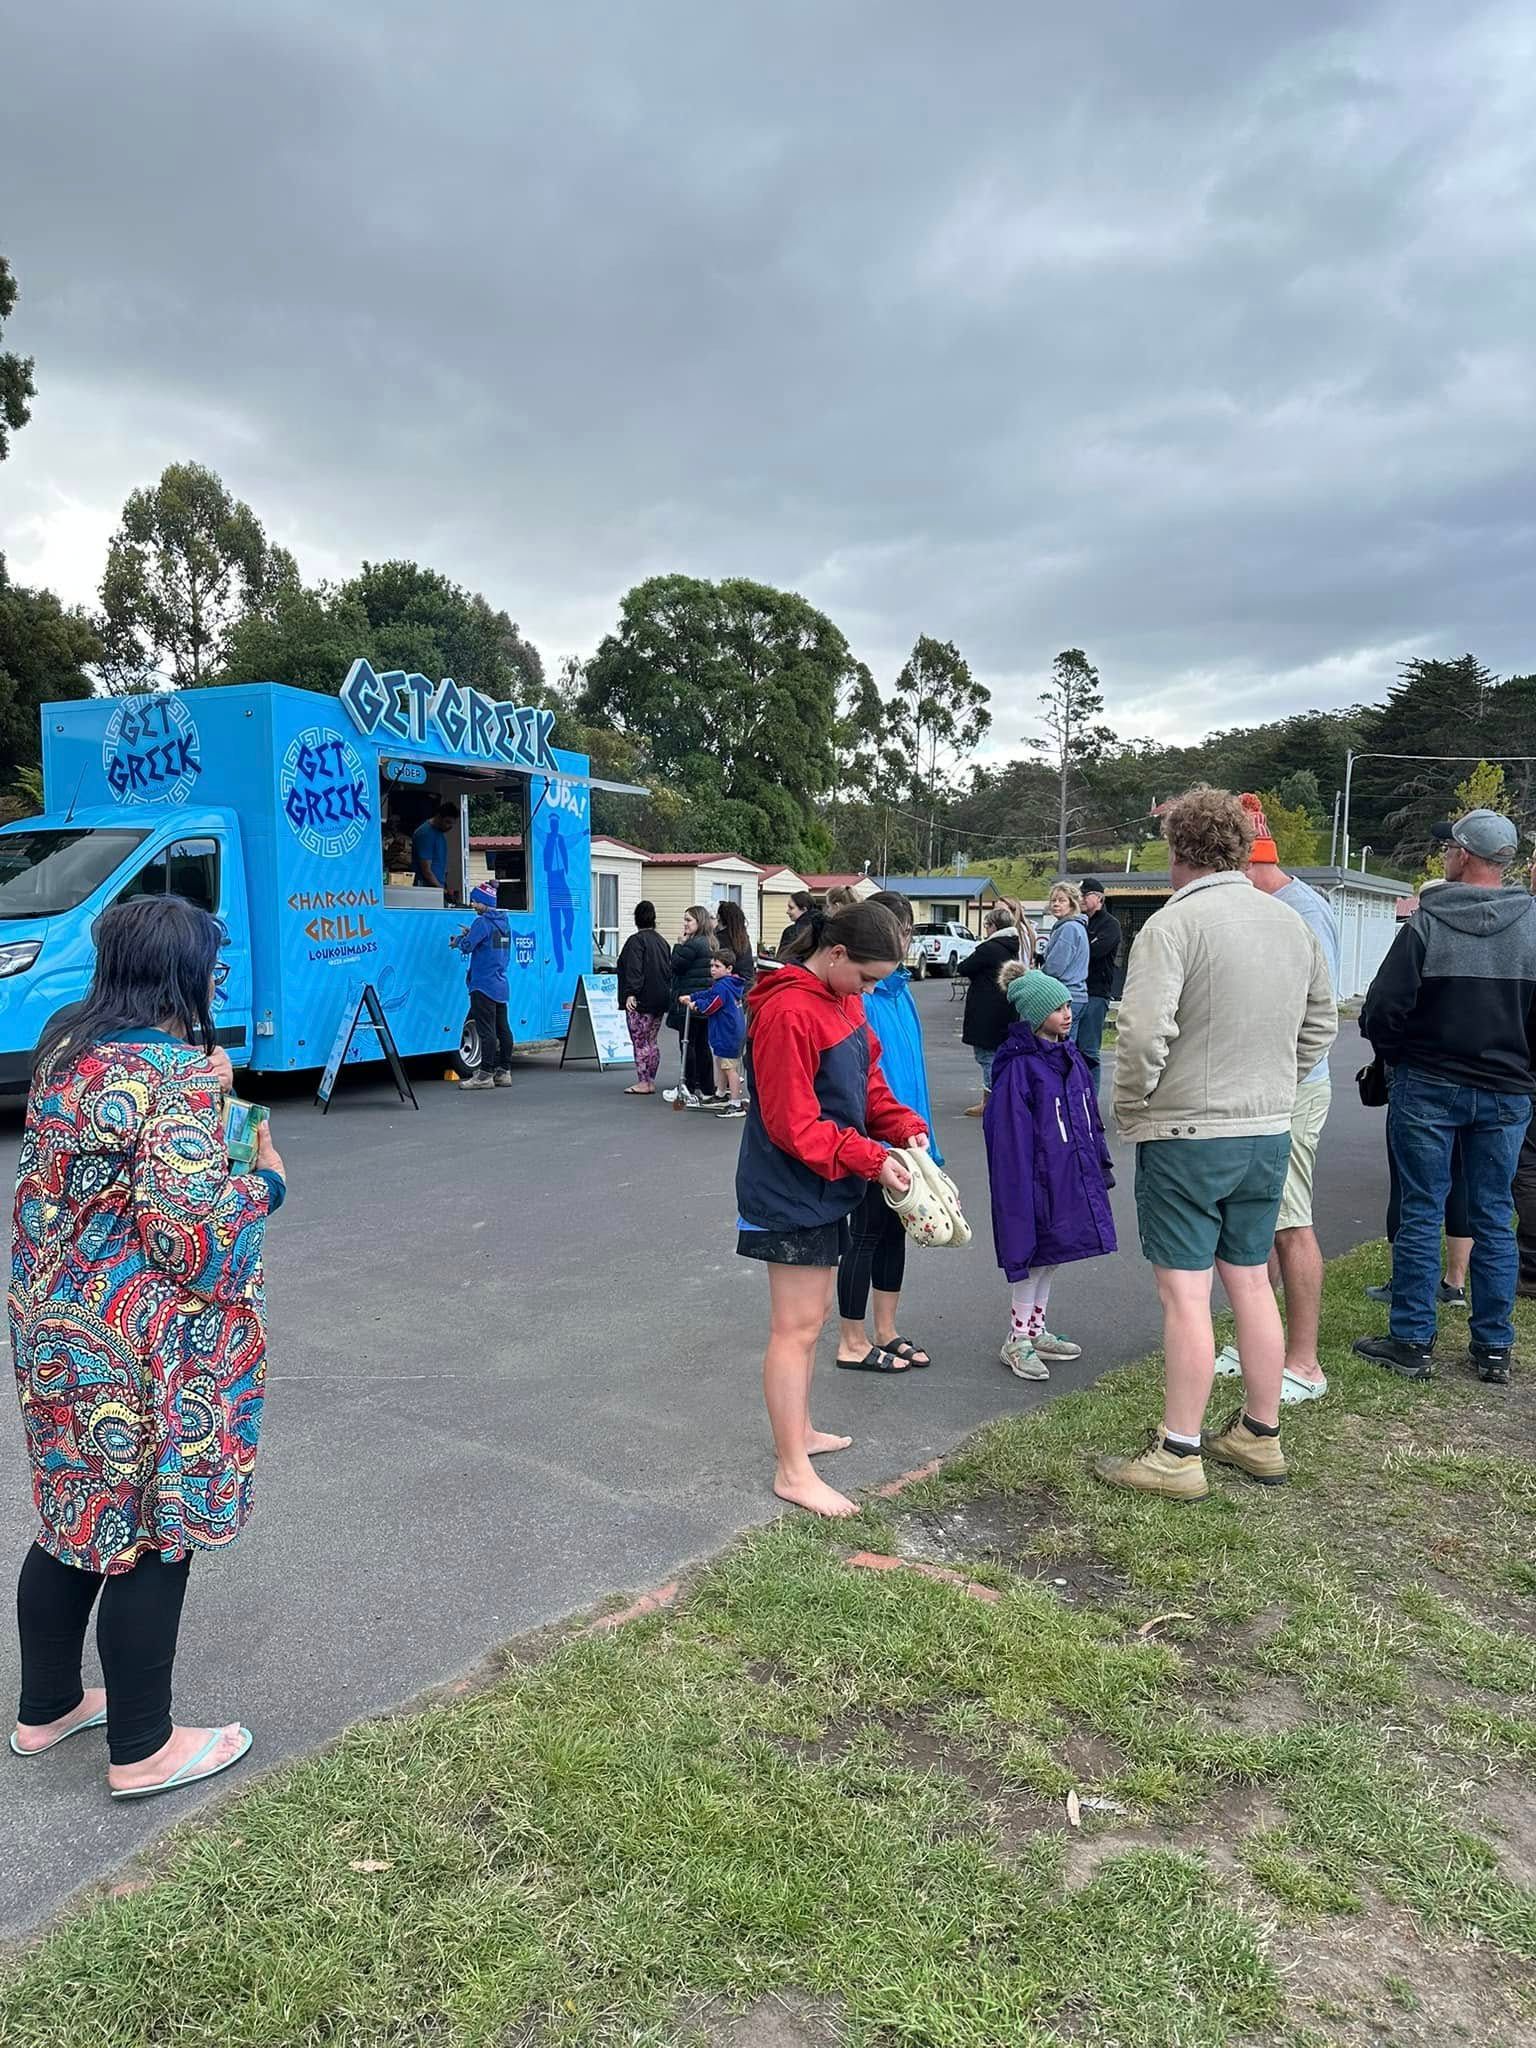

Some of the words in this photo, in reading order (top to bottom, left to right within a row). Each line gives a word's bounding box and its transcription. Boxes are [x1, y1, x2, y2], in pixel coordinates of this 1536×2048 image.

[120, 698, 171, 747] GET
[346, 658, 434, 743] GET
[434, 678, 560, 772] GREEK
[108, 733, 202, 794] GREEK
[297, 740, 345, 782] GET
[286, 780, 371, 828] GREEK
[288, 888, 379, 911] CHARCOAL
[304, 914, 374, 943] GRILL
[515, 937, 534, 949] FRESH
[308, 941, 378, 961] LOUKOUMADES
[515, 950, 534, 964] LOCAL
